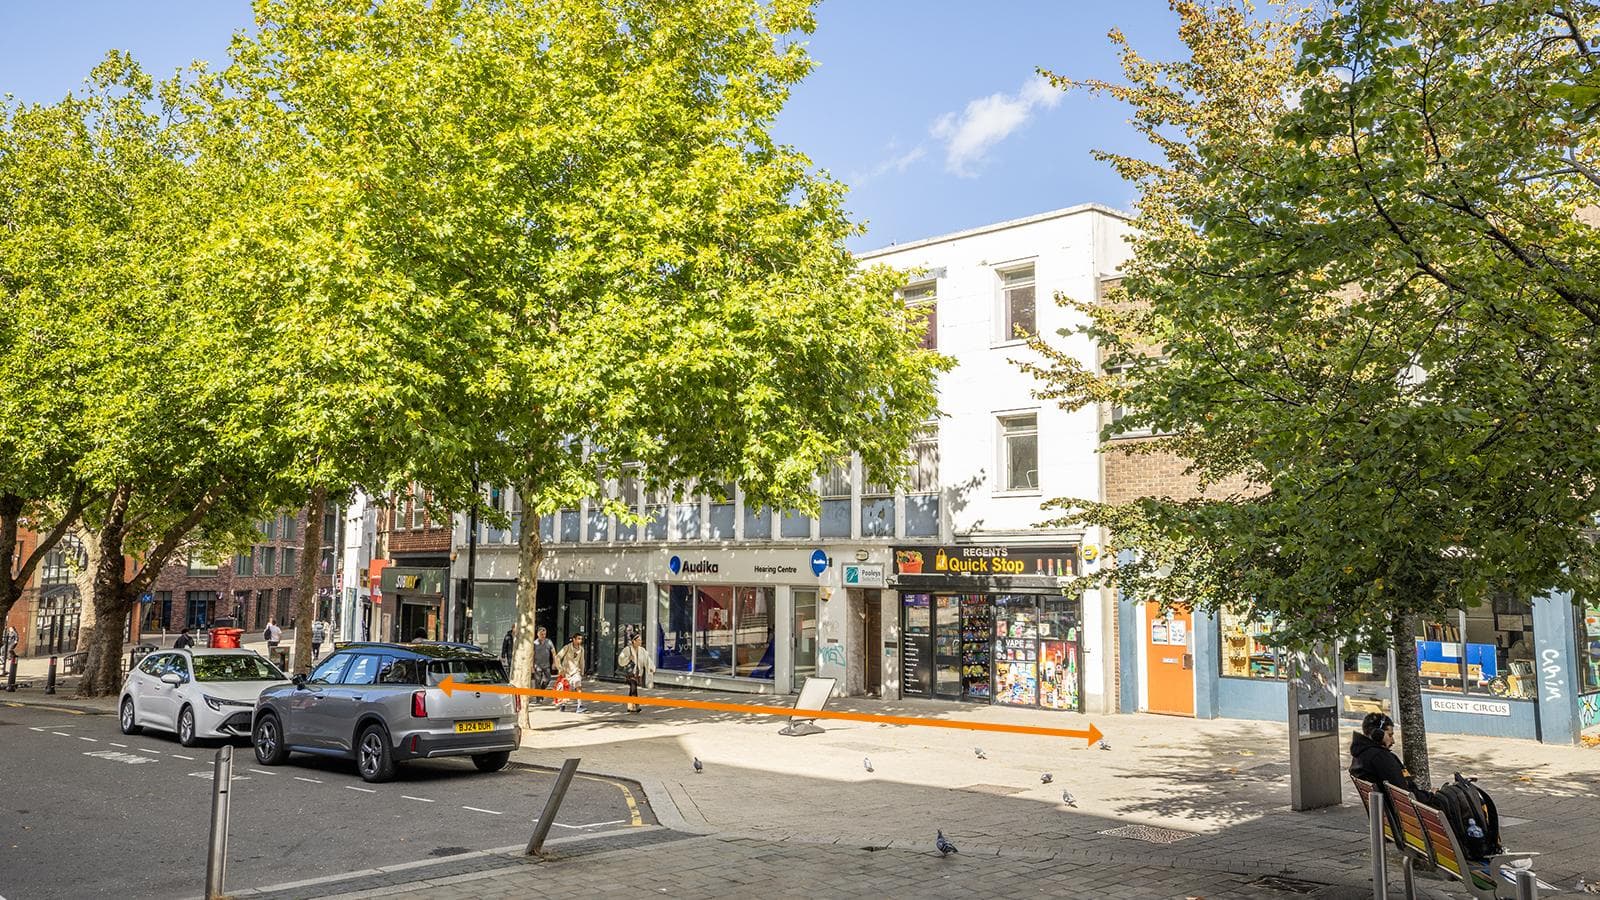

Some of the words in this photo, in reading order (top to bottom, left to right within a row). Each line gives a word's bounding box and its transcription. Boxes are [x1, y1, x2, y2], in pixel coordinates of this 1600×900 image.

[963, 548, 1008, 557] REGENTS
[682, 560, 719, 573] Audika
[754, 565, 777, 574] Hearing
[777, 565, 797, 573] Centre
[949, 557, 988, 572] Quick
[992, 557, 1025, 574] Stop
[861, 570, 881, 578] Pooleys
[1006, 639, 1024, 648] VAPE
[1434, 701, 1469, 710] REGENT
[1473, 703, 1507, 713] CIRCUS
[458, 723, 476, 732] BJ24
